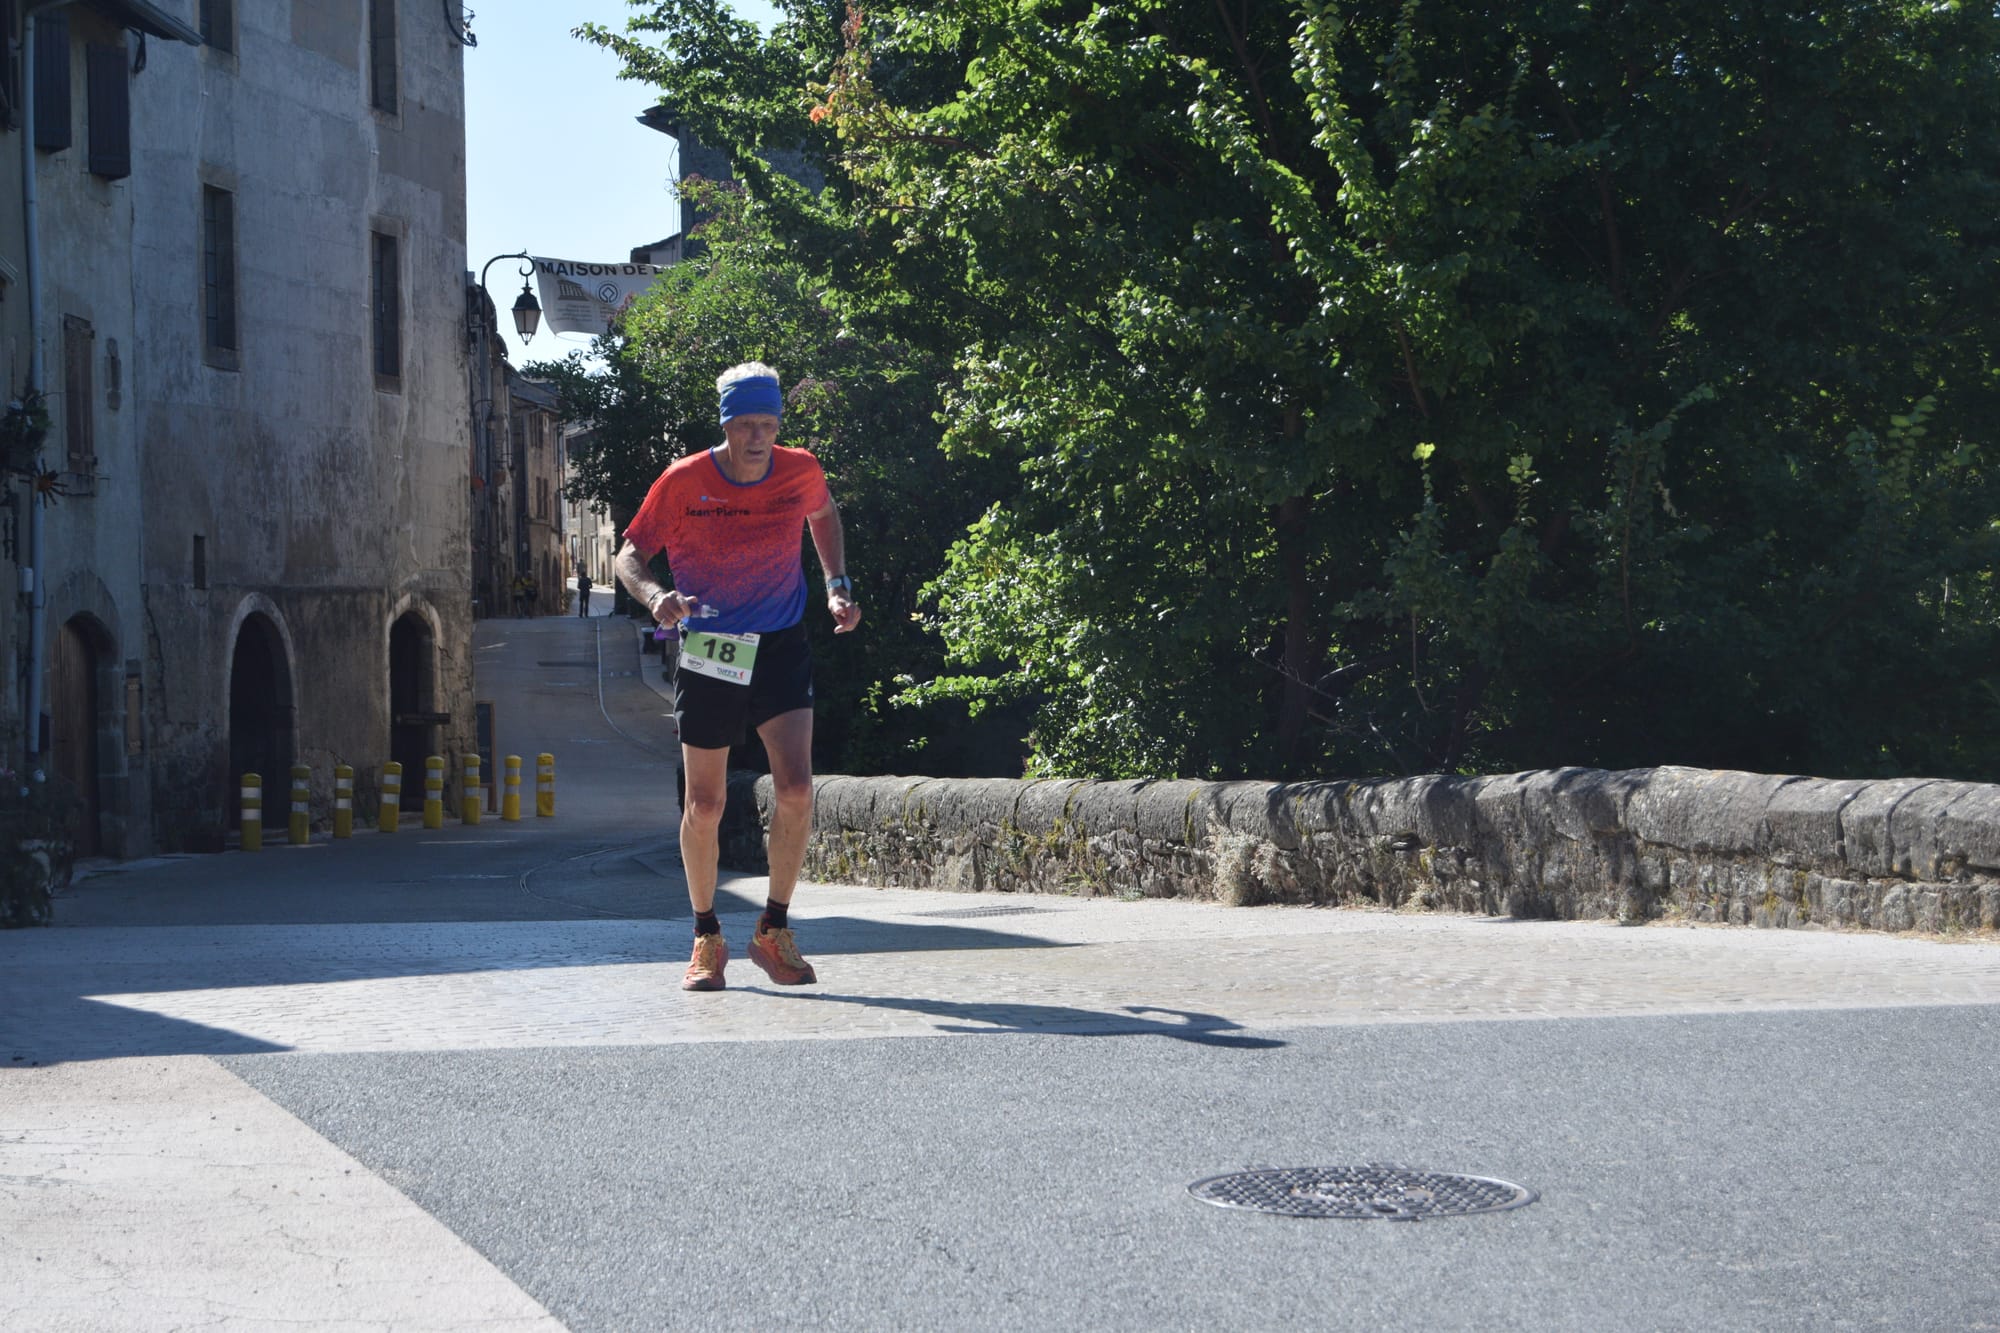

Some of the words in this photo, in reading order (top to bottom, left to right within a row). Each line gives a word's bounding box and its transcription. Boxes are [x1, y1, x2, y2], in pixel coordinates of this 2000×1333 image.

[541, 262, 617, 276] MAISON
[623, 264, 648, 275] DE
[686, 506, 750, 517] Jean-Pierre
[704, 639, 736, 663] 18
